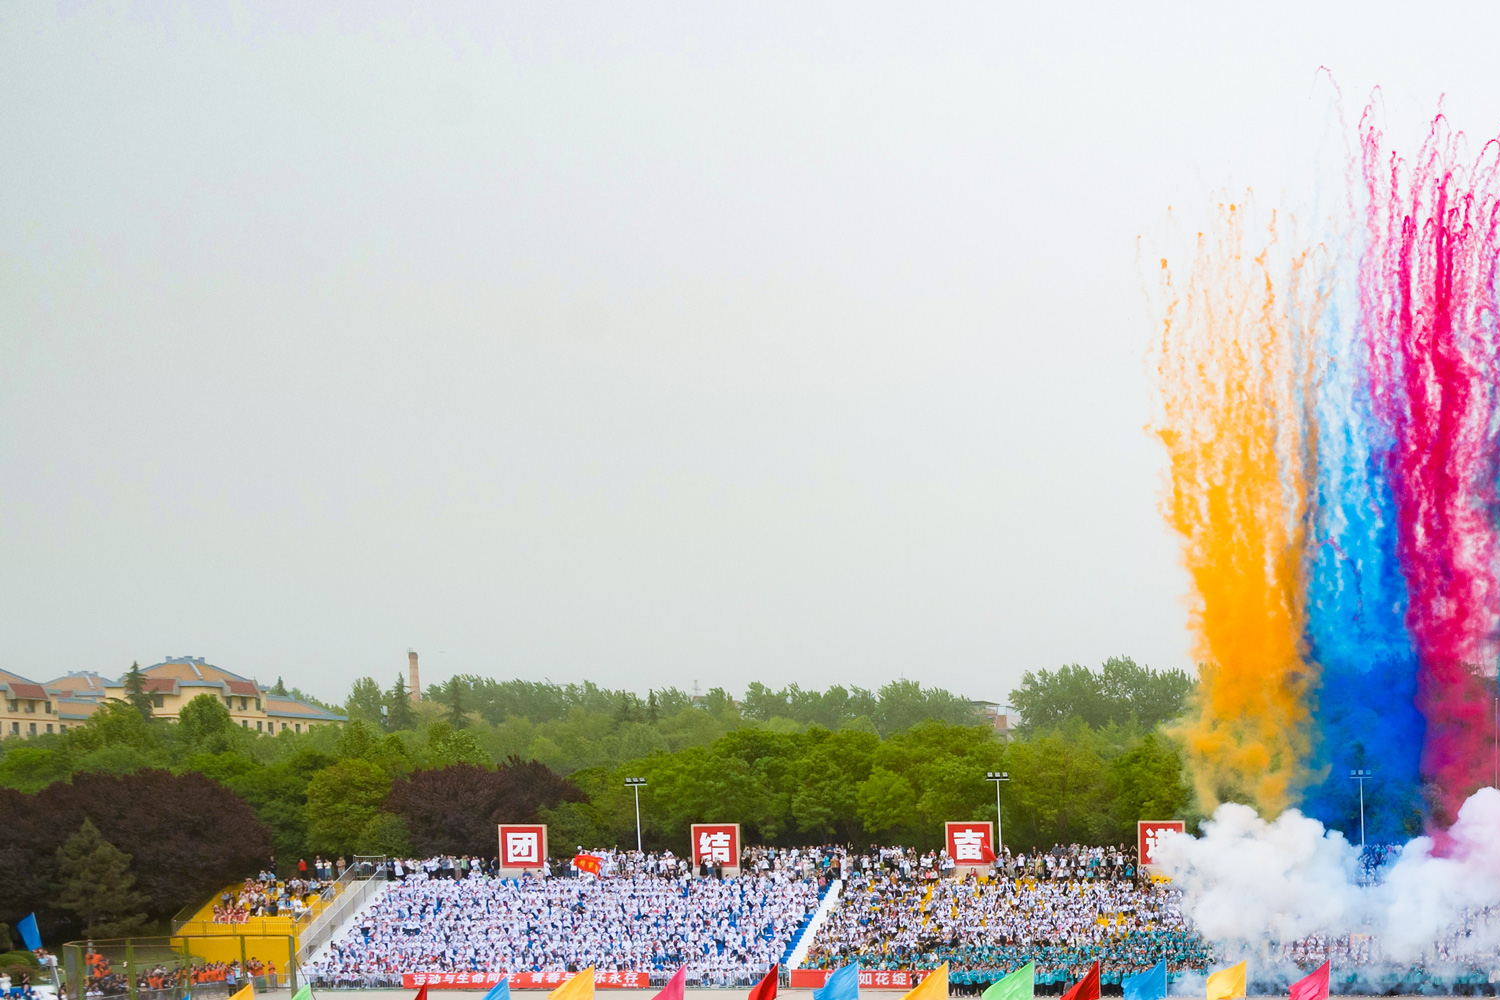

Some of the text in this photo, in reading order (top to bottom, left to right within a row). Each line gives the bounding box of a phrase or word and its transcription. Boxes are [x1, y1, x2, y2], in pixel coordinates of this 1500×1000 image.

[506, 832, 538, 863] 团
[699, 831, 731, 863] 结
[953, 829, 985, 860] 奋
[413, 972, 638, 985] 运动与生命同在，青春与乐永存
